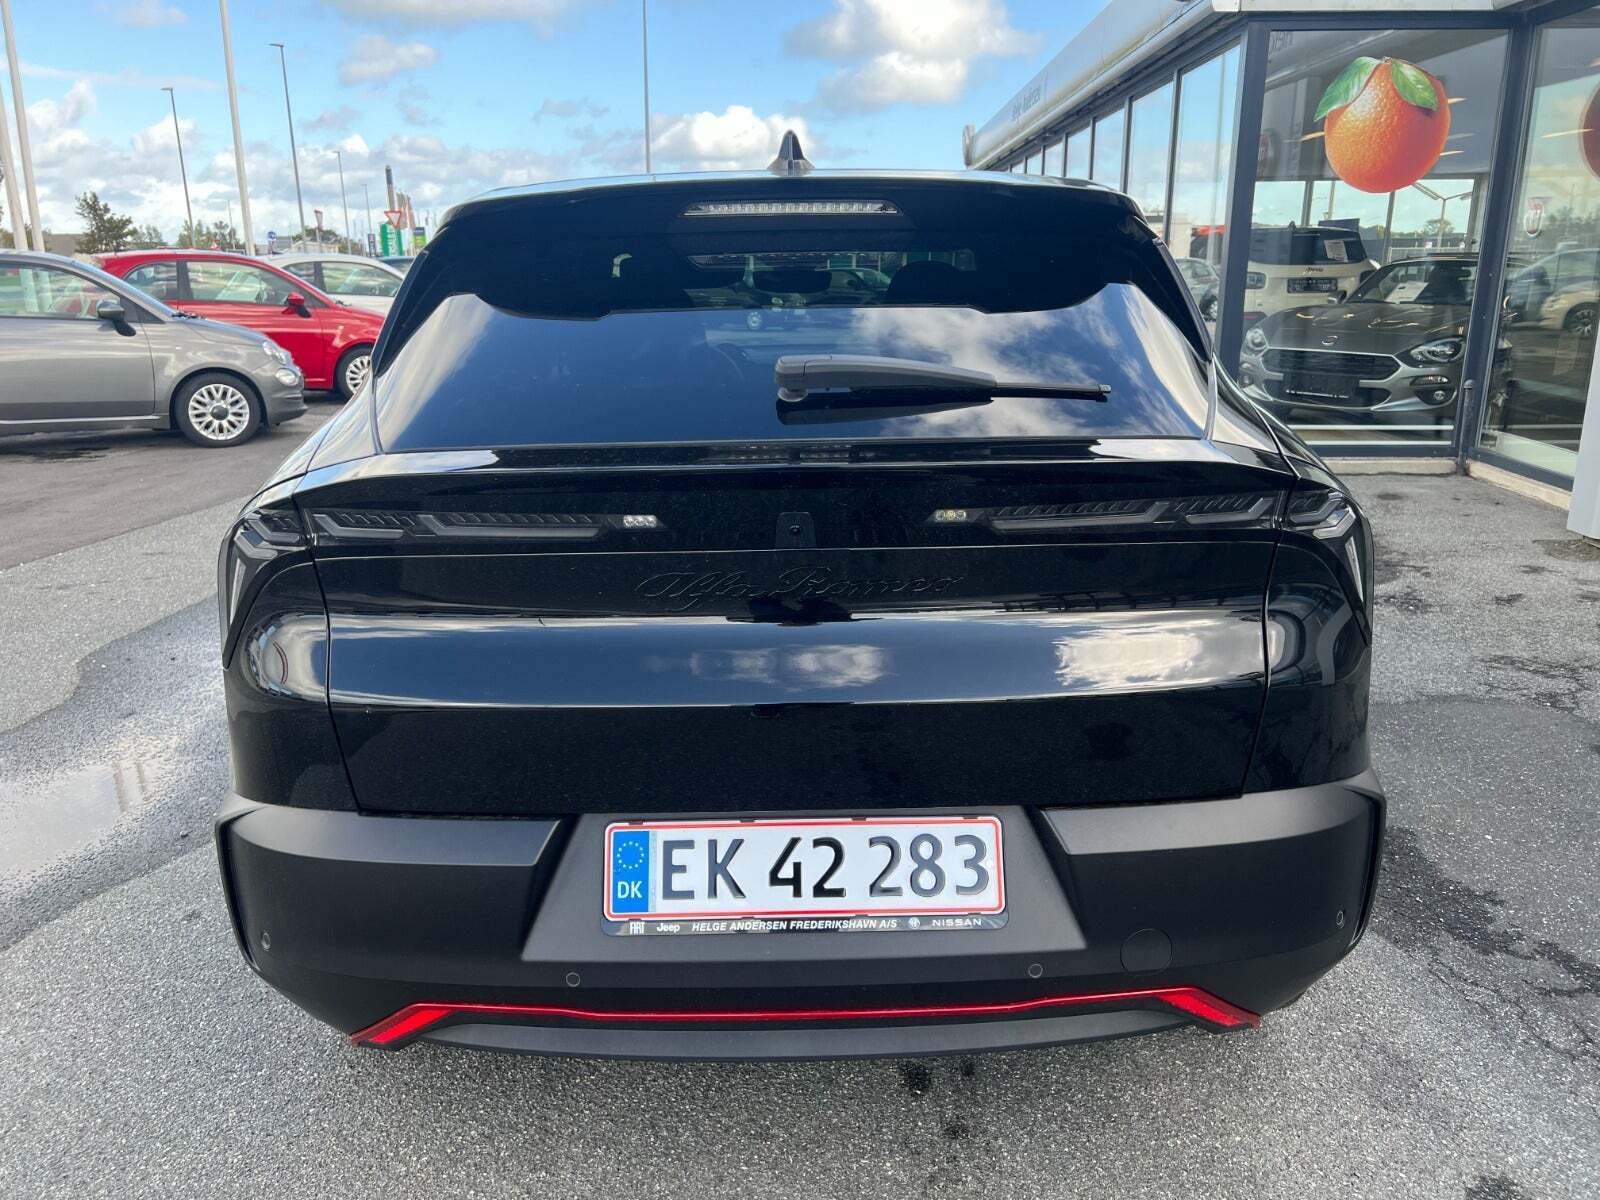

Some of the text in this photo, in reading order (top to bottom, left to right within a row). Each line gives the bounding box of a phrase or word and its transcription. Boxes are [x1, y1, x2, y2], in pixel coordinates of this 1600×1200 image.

[633, 565, 964, 612] Alfa Romeo
[662, 832, 990, 900] EK 42 283
[616, 880, 643, 899] DK
[629, 921, 645, 935] FIAT
[656, 922, 680, 933] Jeep
[691, 918, 898, 932] HELGE ANDERSEN FREDERIKSHAVN A/S
[931, 917, 982, 927] NISSAN
